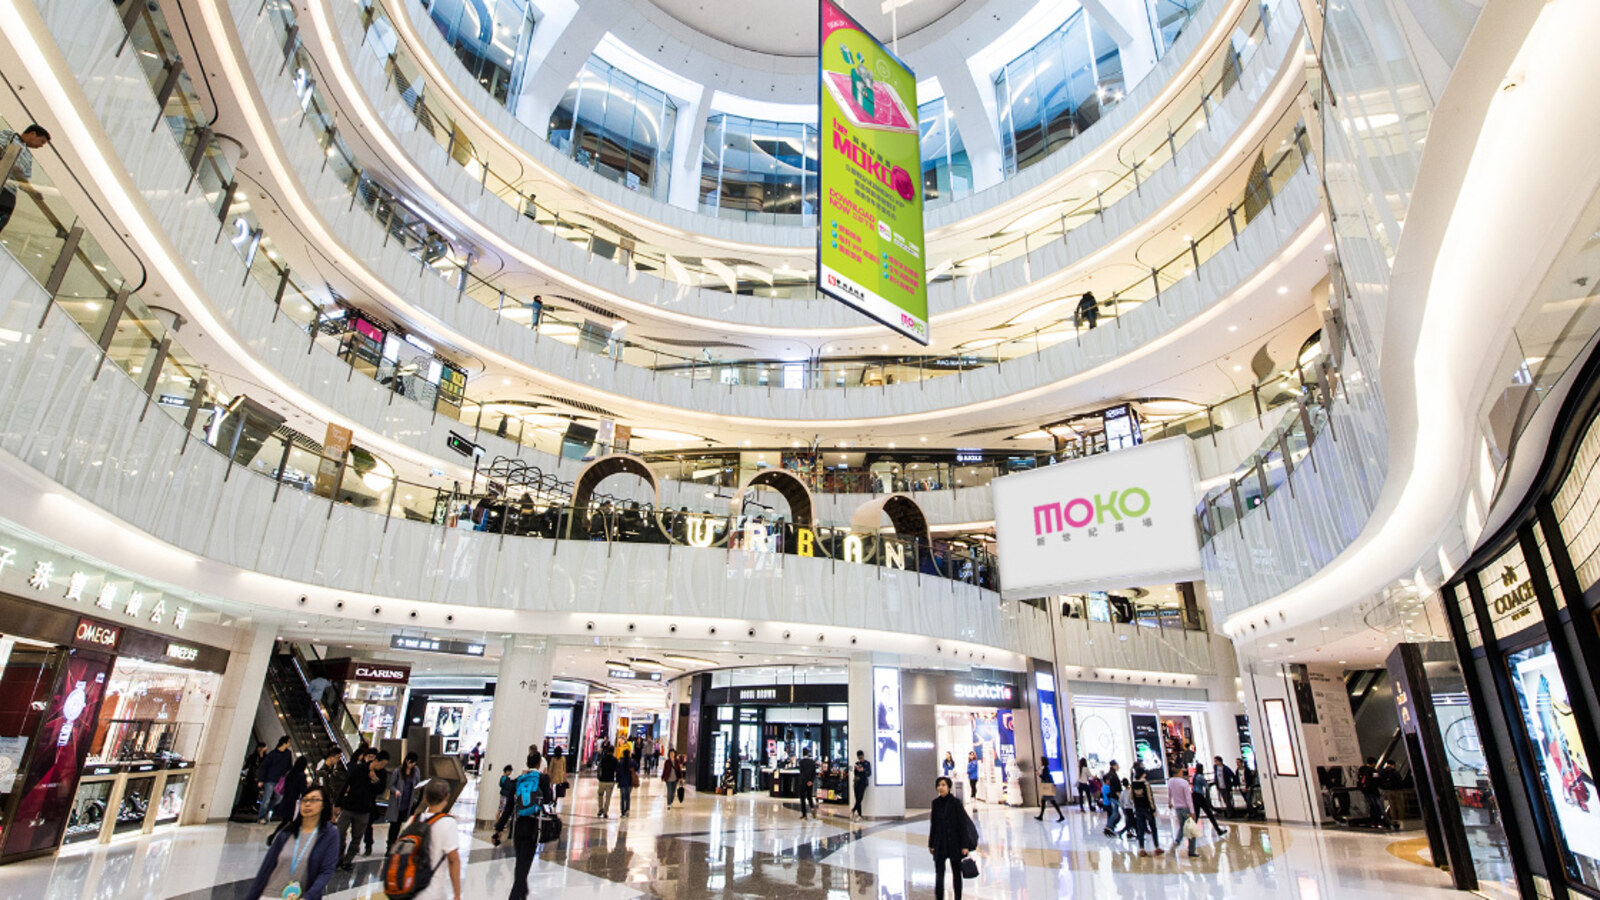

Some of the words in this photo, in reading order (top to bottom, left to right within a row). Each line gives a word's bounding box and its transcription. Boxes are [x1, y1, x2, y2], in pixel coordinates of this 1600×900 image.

[829, 187, 876, 224] DOWNLOAD
[829, 197, 850, 216] NOW
[1033, 486, 1151, 536] MOKO
[1036, 517, 1153, 547] 新世紀廣場
[76, 623, 117, 646] OMEGA
[355, 667, 404, 679] CLARINS
[953, 683, 1005, 700] swatch
